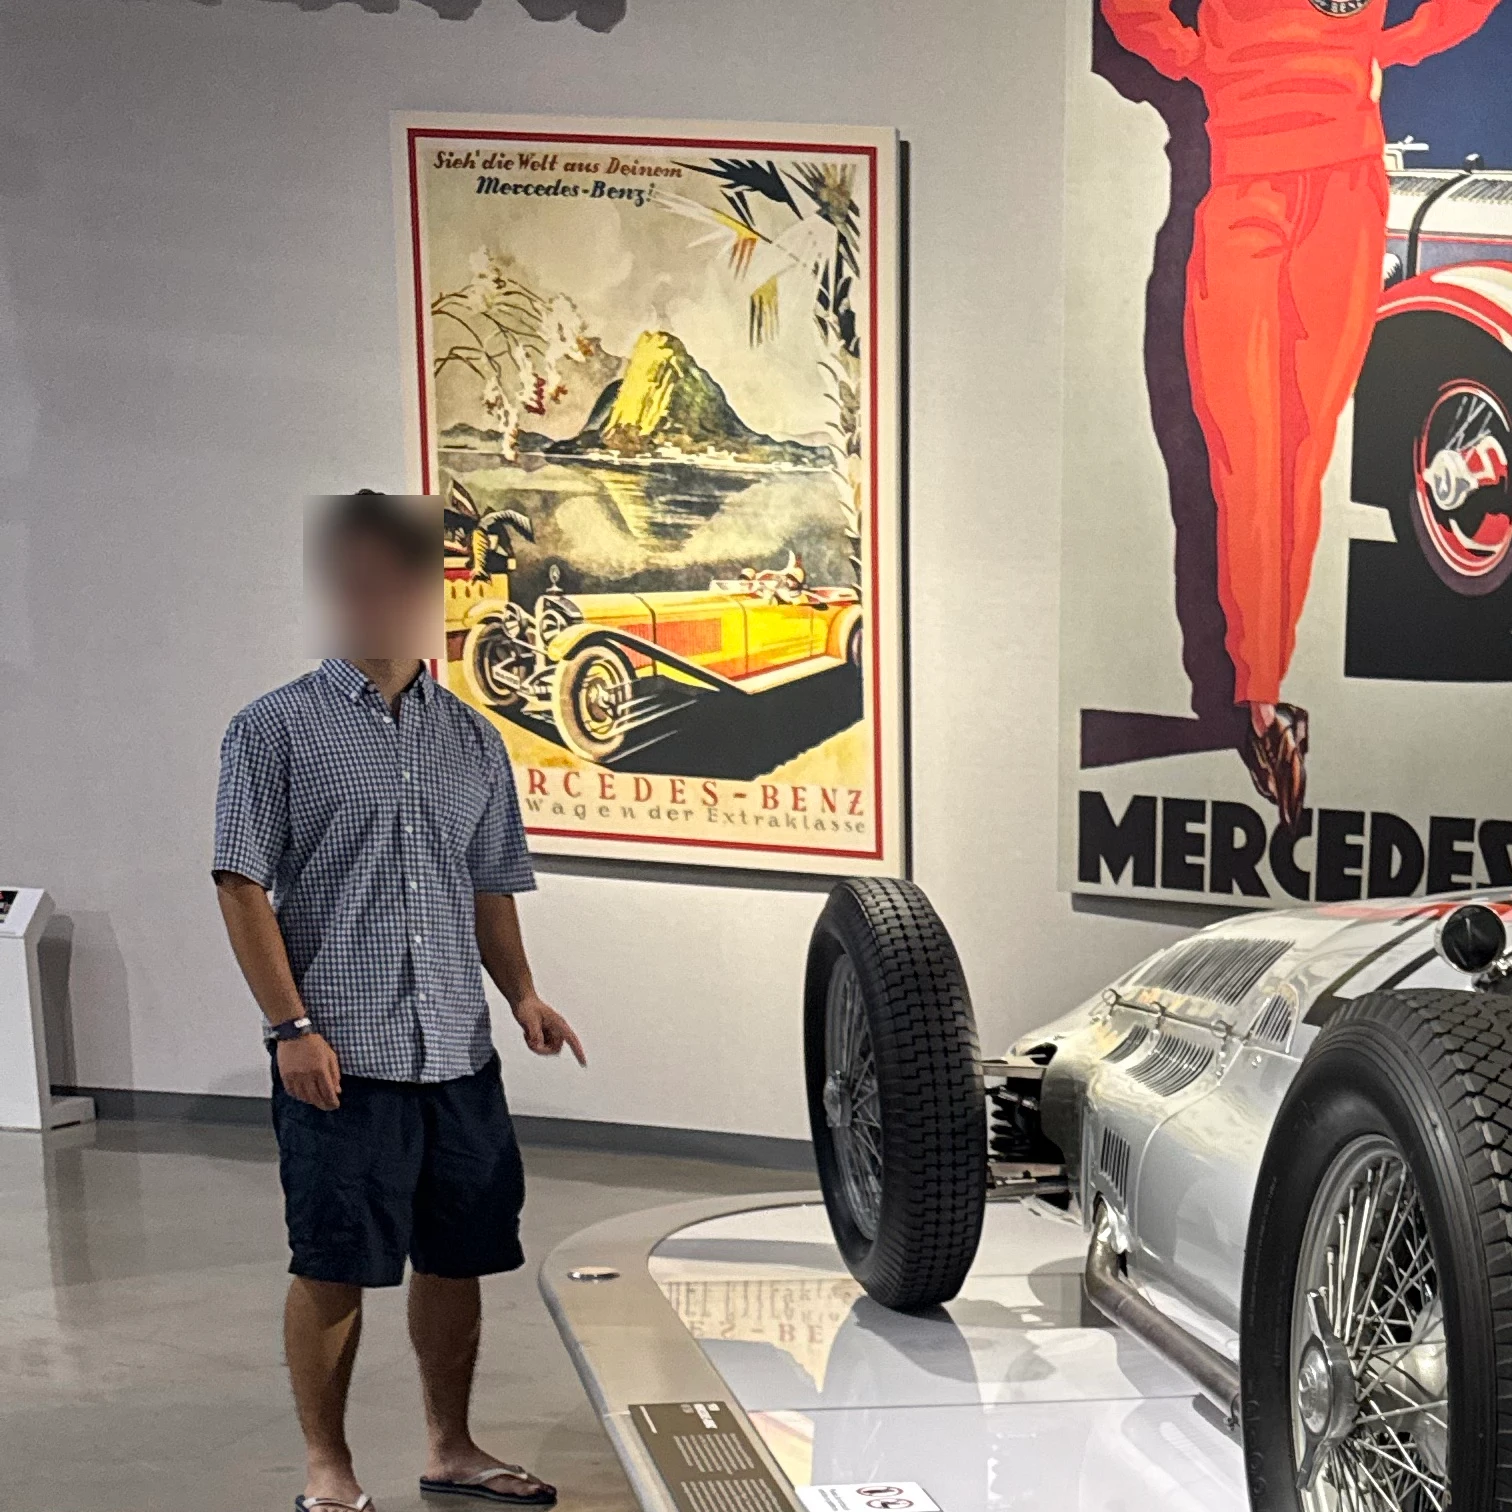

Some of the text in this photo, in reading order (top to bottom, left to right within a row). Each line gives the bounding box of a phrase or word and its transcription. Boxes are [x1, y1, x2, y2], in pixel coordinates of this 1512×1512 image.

[482, 152, 514, 170] die
[518, 151, 559, 171] Welt
[563, 161, 600, 173] aus
[605, 156, 683, 178] Deinem
[475, 175, 656, 207] Mercedes-Benz!
[527, 768, 865, 816] RCEDES-BENZ
[649, 804, 694, 822] der
[707, 807, 866, 833] Extraklasse
